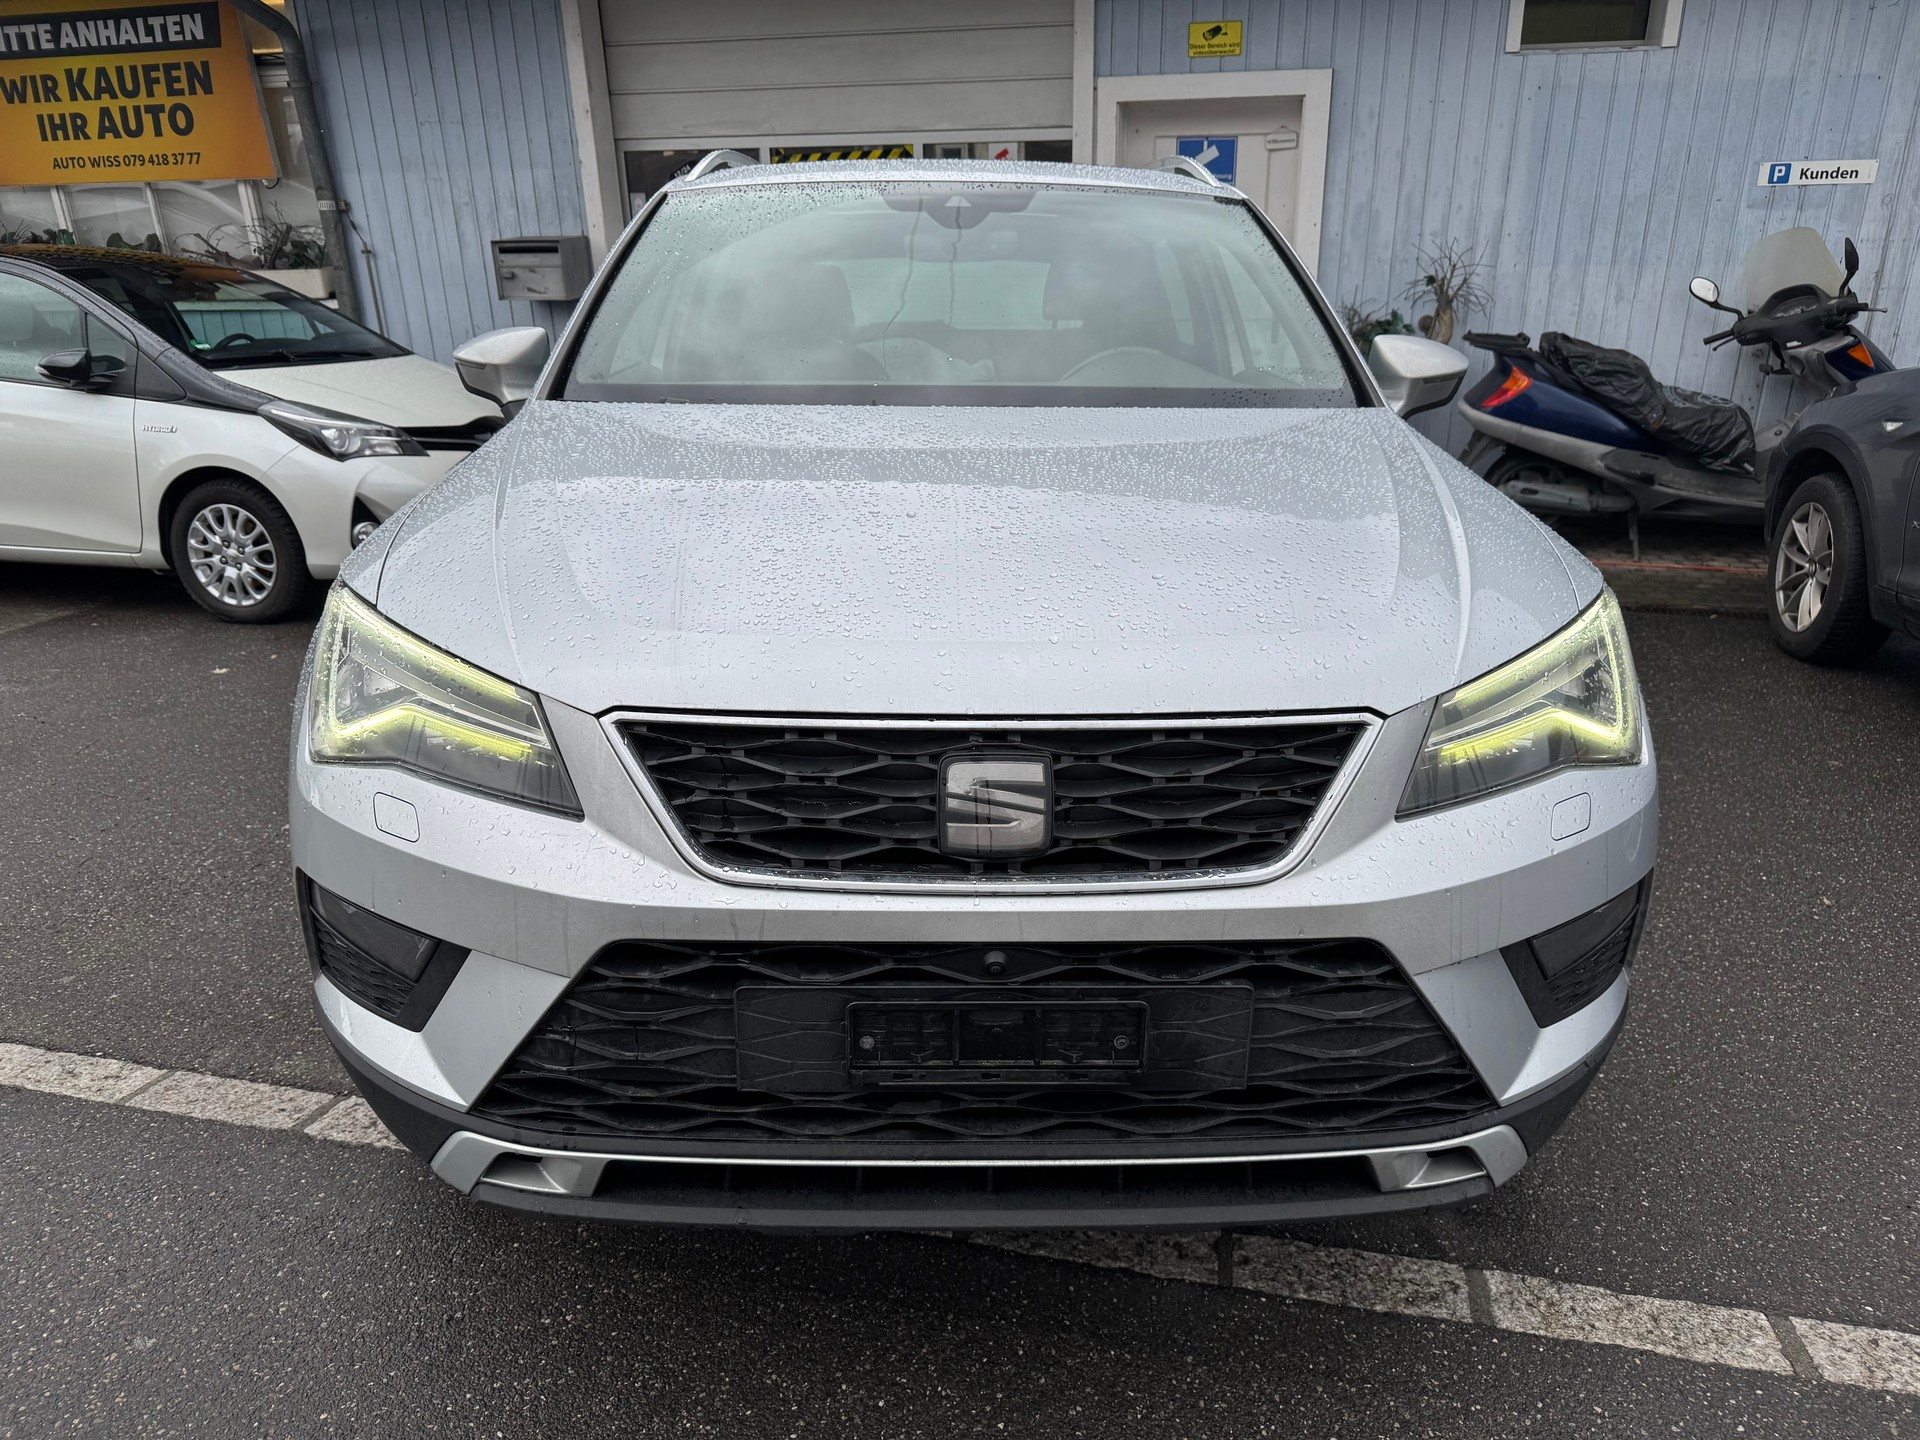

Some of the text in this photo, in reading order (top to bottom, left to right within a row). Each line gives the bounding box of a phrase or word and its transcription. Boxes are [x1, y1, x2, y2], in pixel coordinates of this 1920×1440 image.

[0, 13, 204, 51] ITTE ANHALTEN
[0, 60, 213, 104] WIR KAUFEN
[36, 102, 195, 142] IHR AUTO
[52, 156, 86, 170] AUTO
[88, 155, 121, 169] WISS
[123, 154, 146, 168] 079
[147, 152, 169, 166] 418
[1773, 165, 1859, 182] P Kunden
